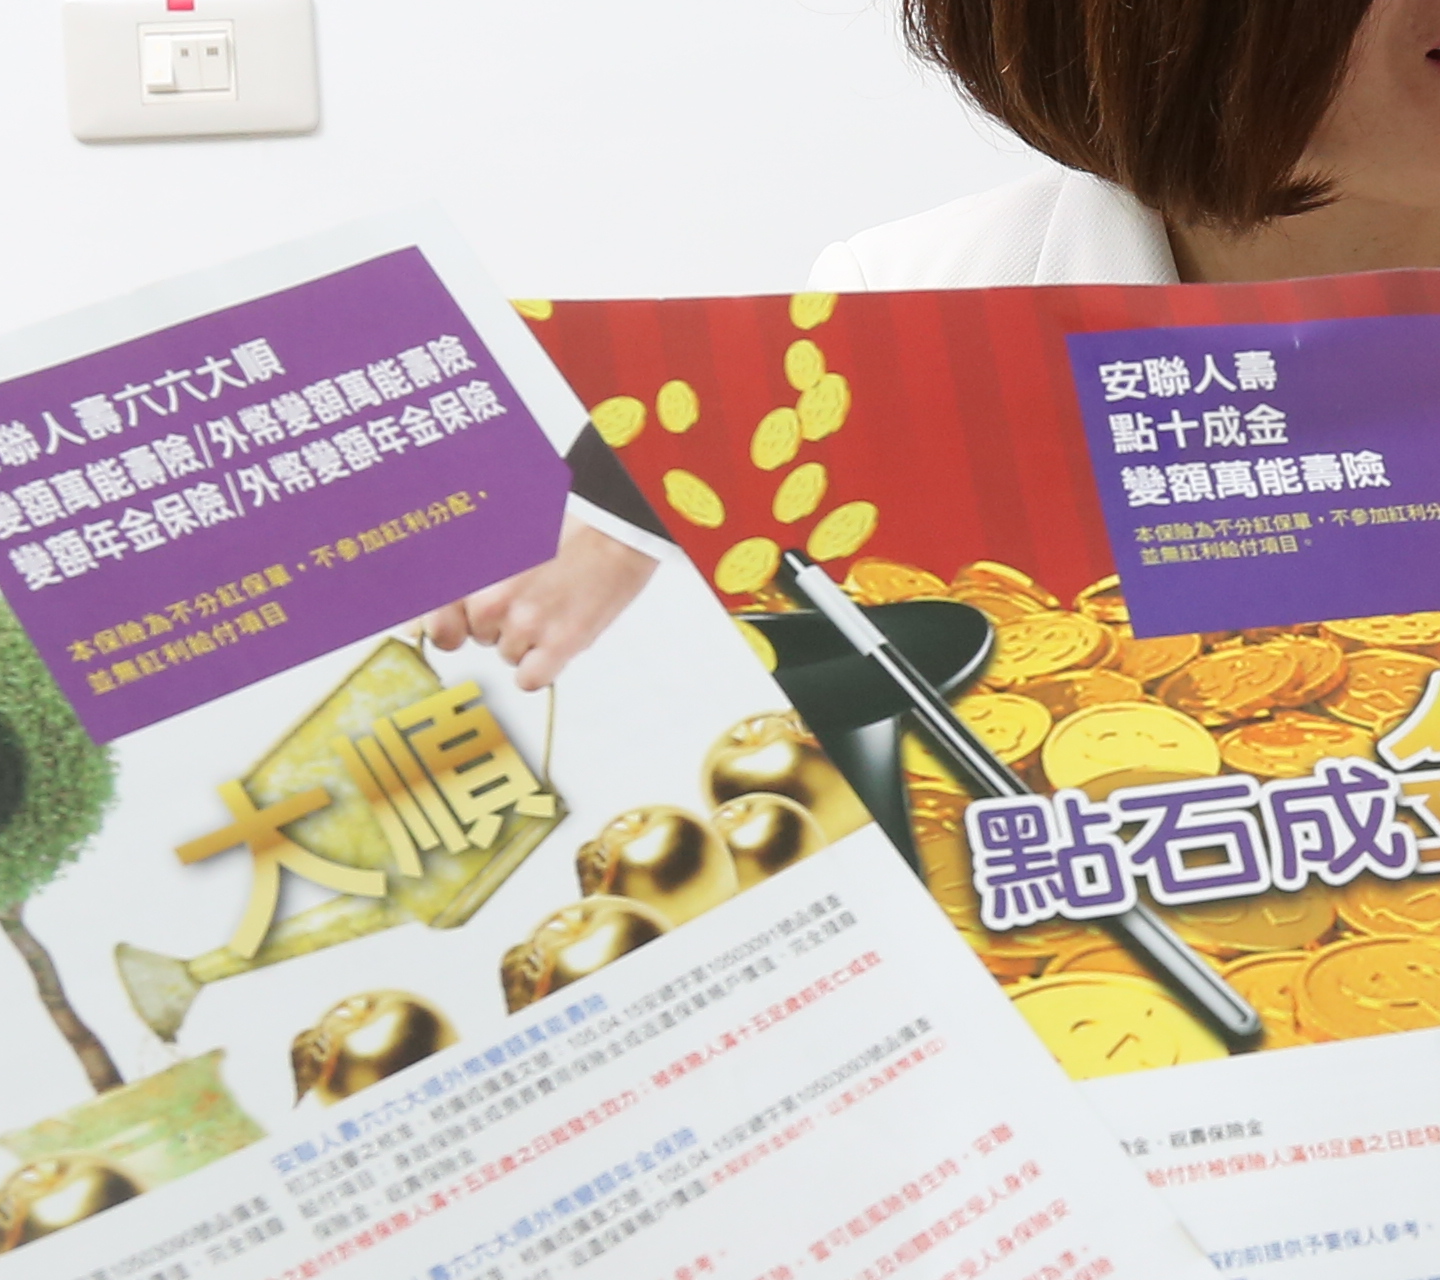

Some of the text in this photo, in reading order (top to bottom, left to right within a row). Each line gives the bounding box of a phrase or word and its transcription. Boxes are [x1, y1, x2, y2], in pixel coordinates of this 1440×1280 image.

[1098, 349, 1278, 402] 安聯人壽
[1108, 402, 1289, 456] 點十成金
[7, 378, 507, 593] 變額年金保險/外幣變額年金保險
[1119, 449, 1392, 508] 變額萬能壽險
[175, 678, 558, 962] 大順
